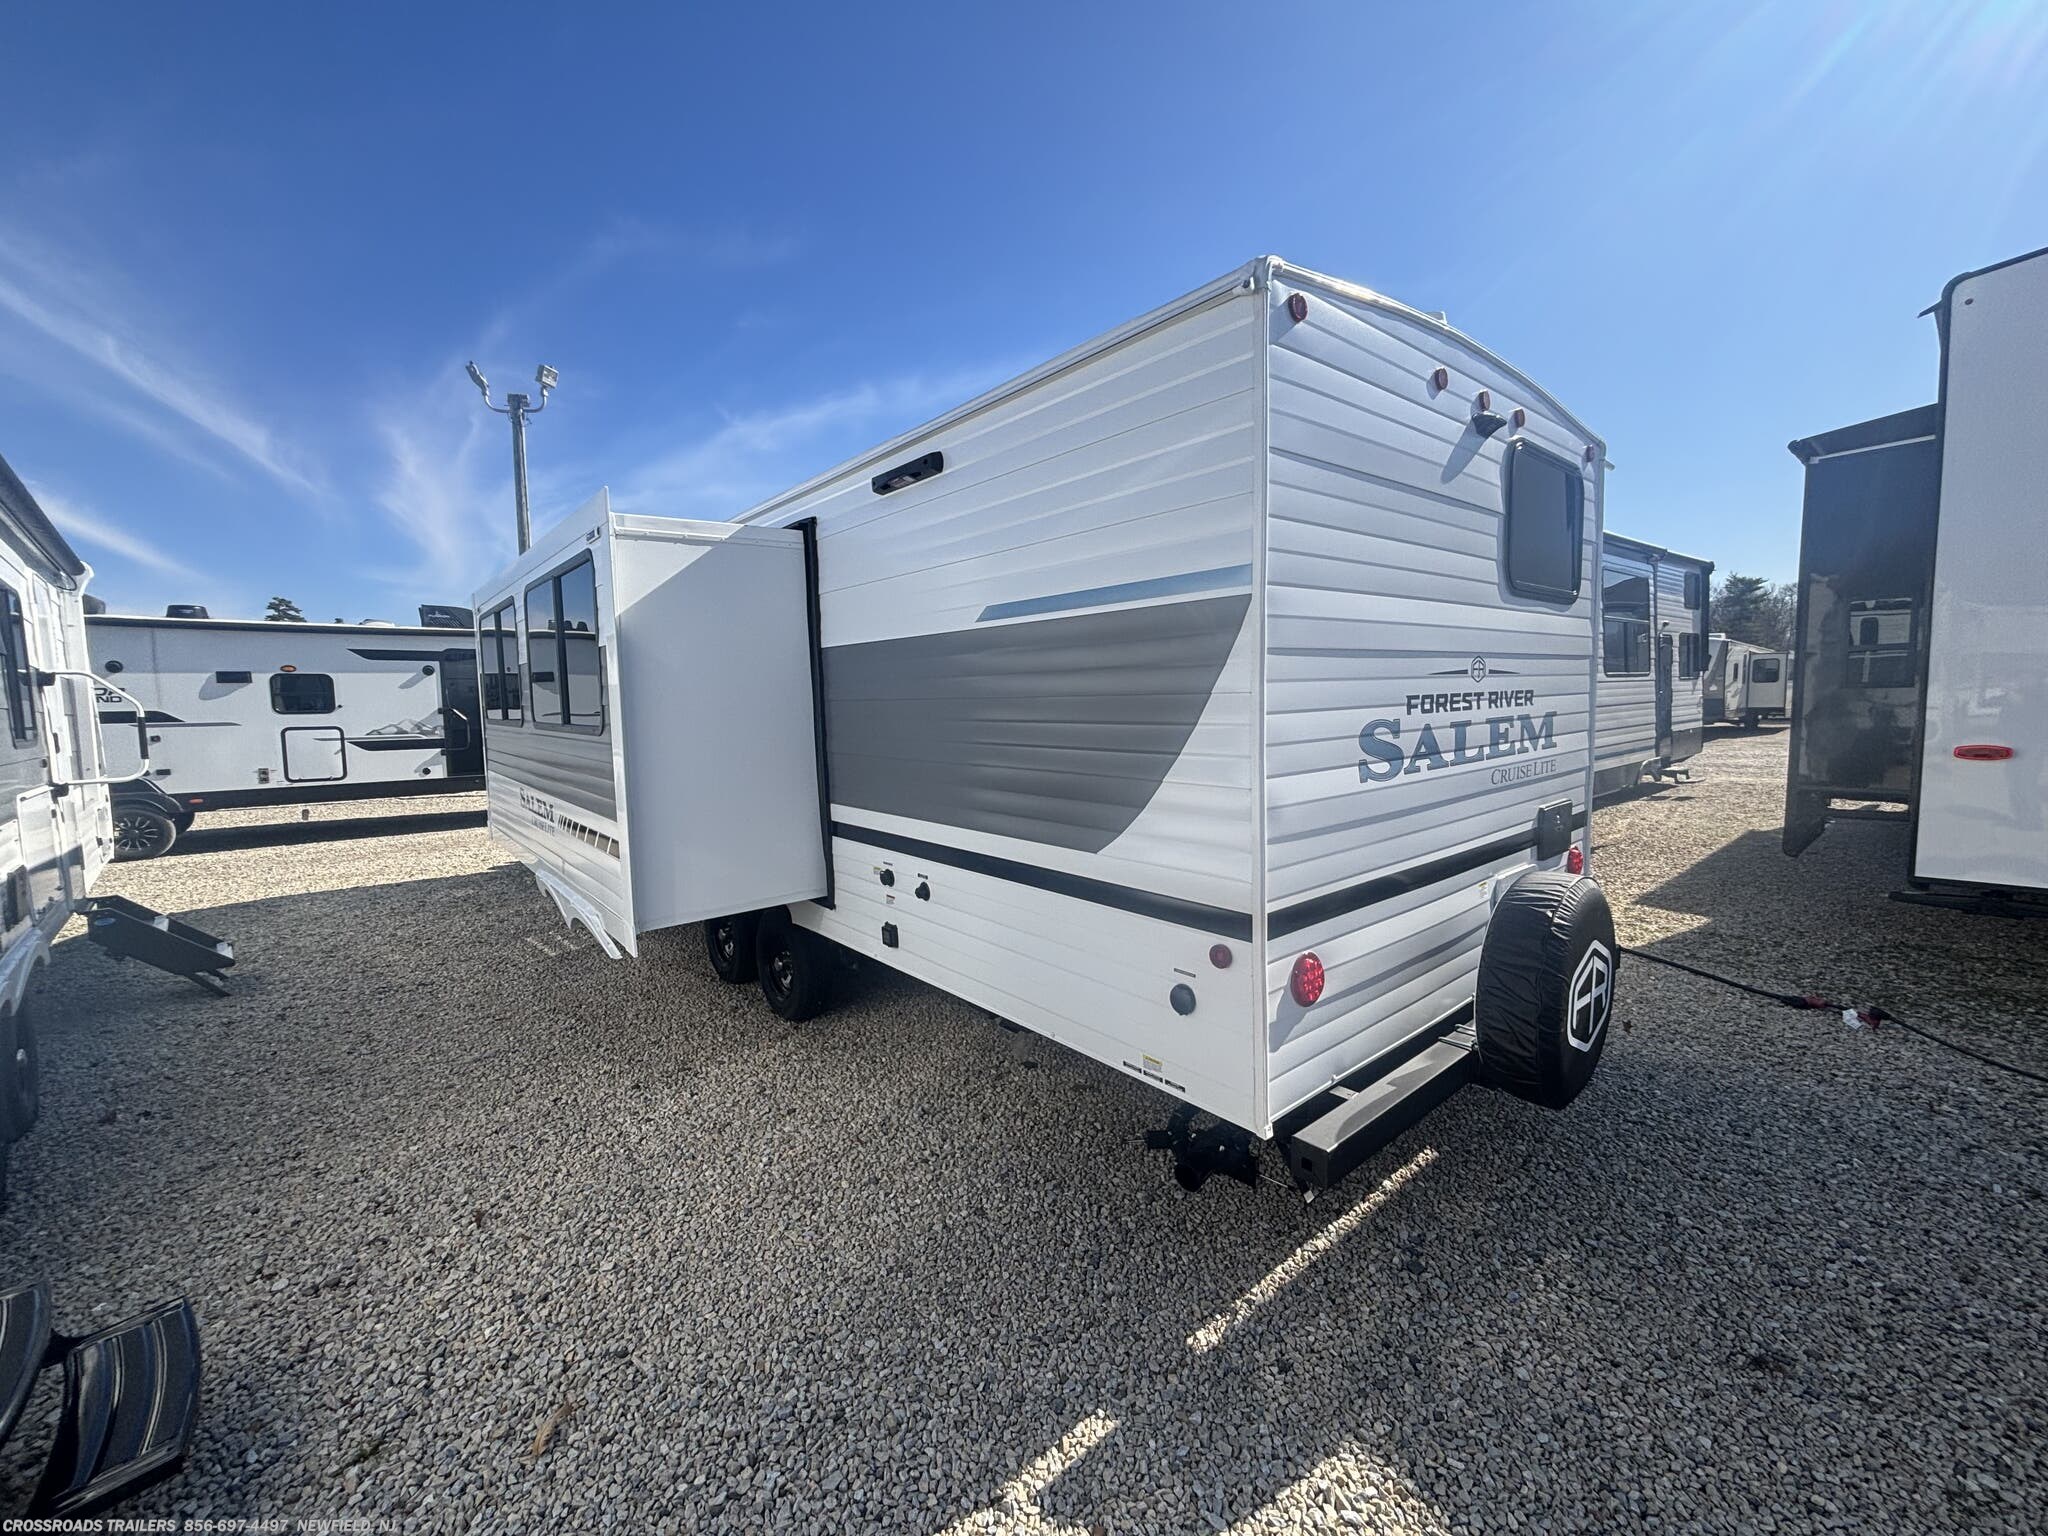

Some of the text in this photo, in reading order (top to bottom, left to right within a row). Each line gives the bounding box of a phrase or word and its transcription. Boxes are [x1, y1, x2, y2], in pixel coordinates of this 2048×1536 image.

[1406, 689, 1534, 715] FOREST RIVER
[1358, 711, 1558, 783] SALEM
[520, 787, 555, 824] SALEM
